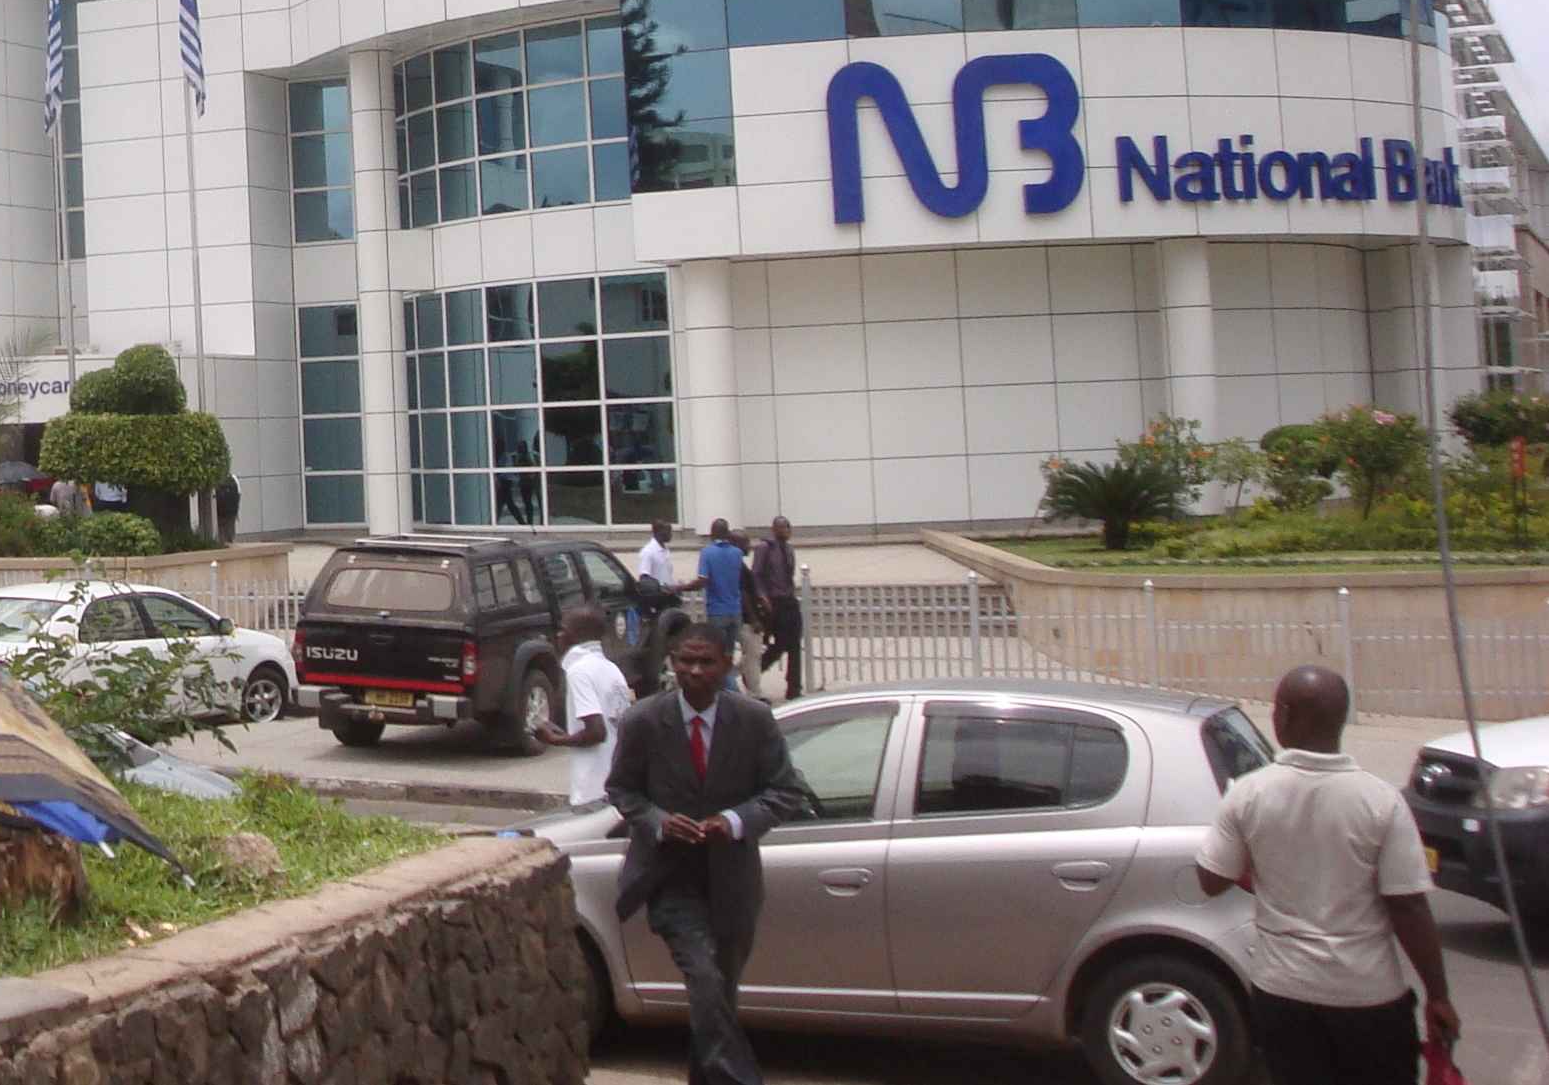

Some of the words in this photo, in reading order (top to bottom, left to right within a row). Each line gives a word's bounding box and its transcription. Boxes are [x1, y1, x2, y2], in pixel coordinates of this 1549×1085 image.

[826, 52, 1085, 224] NB
[1116, 134, 1377, 203] National
[306, 646, 359, 661] ISUZU
